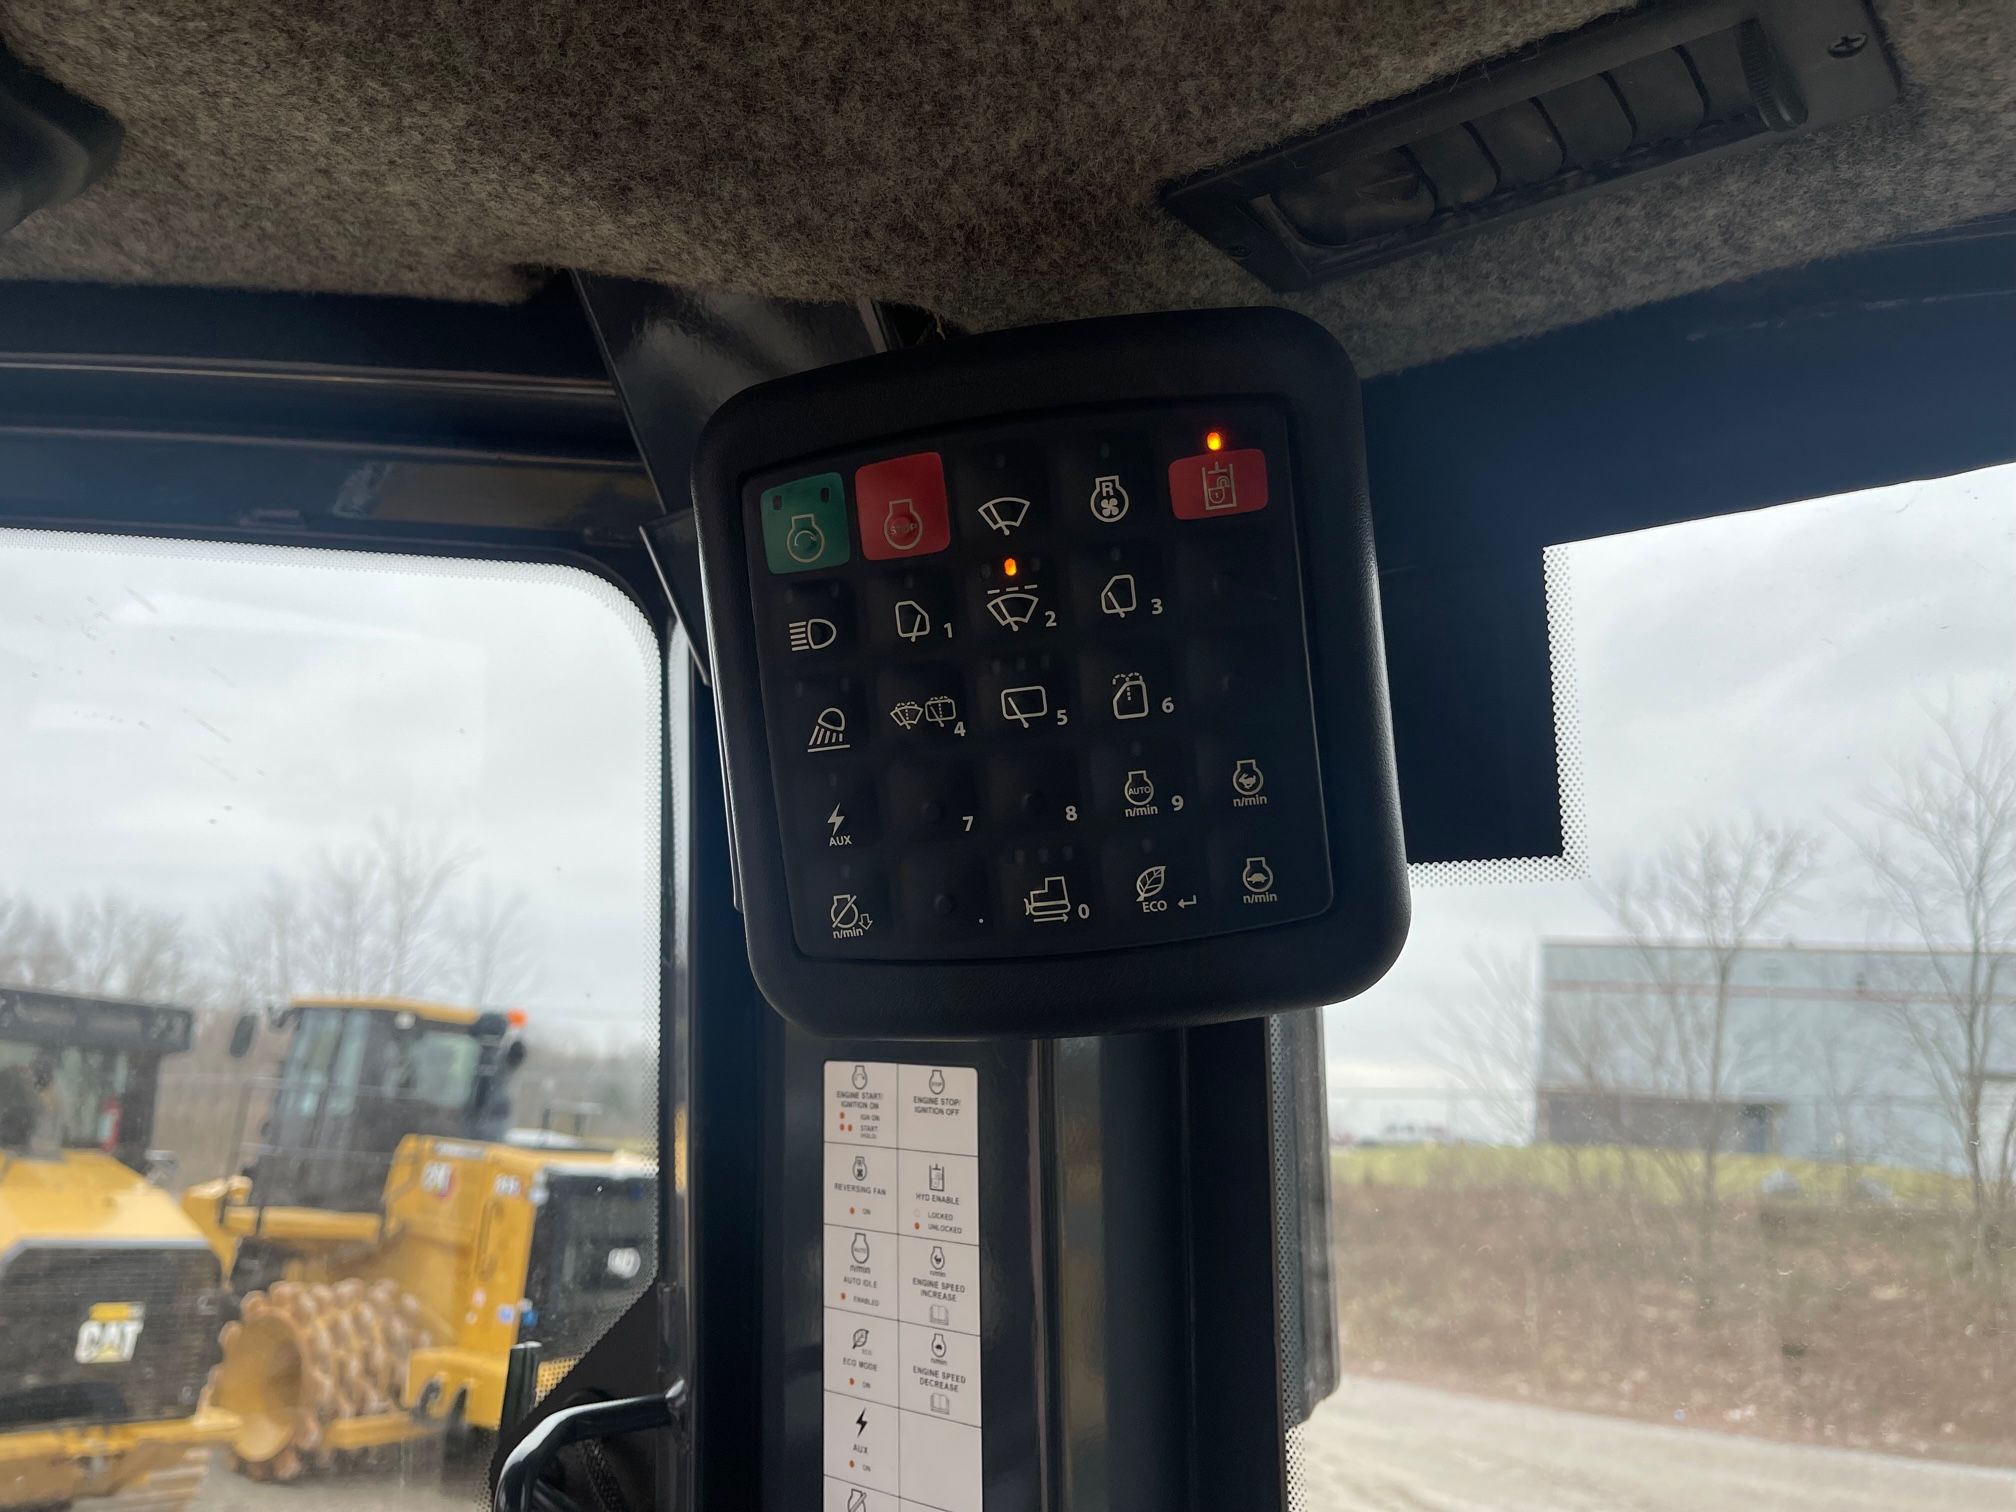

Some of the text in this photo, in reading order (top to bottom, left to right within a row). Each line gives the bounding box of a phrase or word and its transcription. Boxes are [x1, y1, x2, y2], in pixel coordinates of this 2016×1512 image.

[1101, 481, 1114, 497] R
[1151, 598, 1163, 615] 3
[1044, 610, 1057, 627] 2
[943, 622, 953, 638] 1
[1161, 697, 1175, 713] 6
[1056, 709, 1068, 726] 5
[953, 721, 966, 737] 4
[1128, 786, 1151, 795] AUTO
[1171, 795, 1184, 811] 9
[1233, 795, 1267, 807] n/min
[1065, 805, 1078, 821] 8
[1124, 804, 1158, 817] n/min
[962, 815, 974, 832] 7
[829, 835, 852, 847] AUX
[1243, 892, 1278, 904] n/min
[1078, 903, 1090, 919] 0
[1142, 900, 1168, 913] ECO
[833, 926, 864, 939] n/min
[836, 1090, 859, 1099] ENGINE
[913, 1095, 939, 1105] ENGINE
[841, 1100, 880, 1110] IGNITION ON
[914, 1106, 960, 1116] IGNITION OFF
[860, 1124, 879, 1132] START
[834, 1182, 887, 1196] REVERSING FAN
[915, 1192, 960, 1206] HYD ENABLE
[927, 1211, 954, 1221] LOCKED
[927, 1223, 963, 1234] UNLOCKED
[843, 1276, 878, 1289] AUTO IDLE
[912, 1277, 966, 1293] ENGINE SPEED
[852, 1295, 880, 1307] ENABLED
[920, 1289, 958, 1302] INCREASE
[75, 1319, 144, 1363] CAT
[842, 1356, 878, 1372] ECO MODE
[912, 1365, 967, 1384] ENGINE SPEED
[919, 1377, 960, 1393] DECREASE
[852, 1443, 868, 1455] AUX
